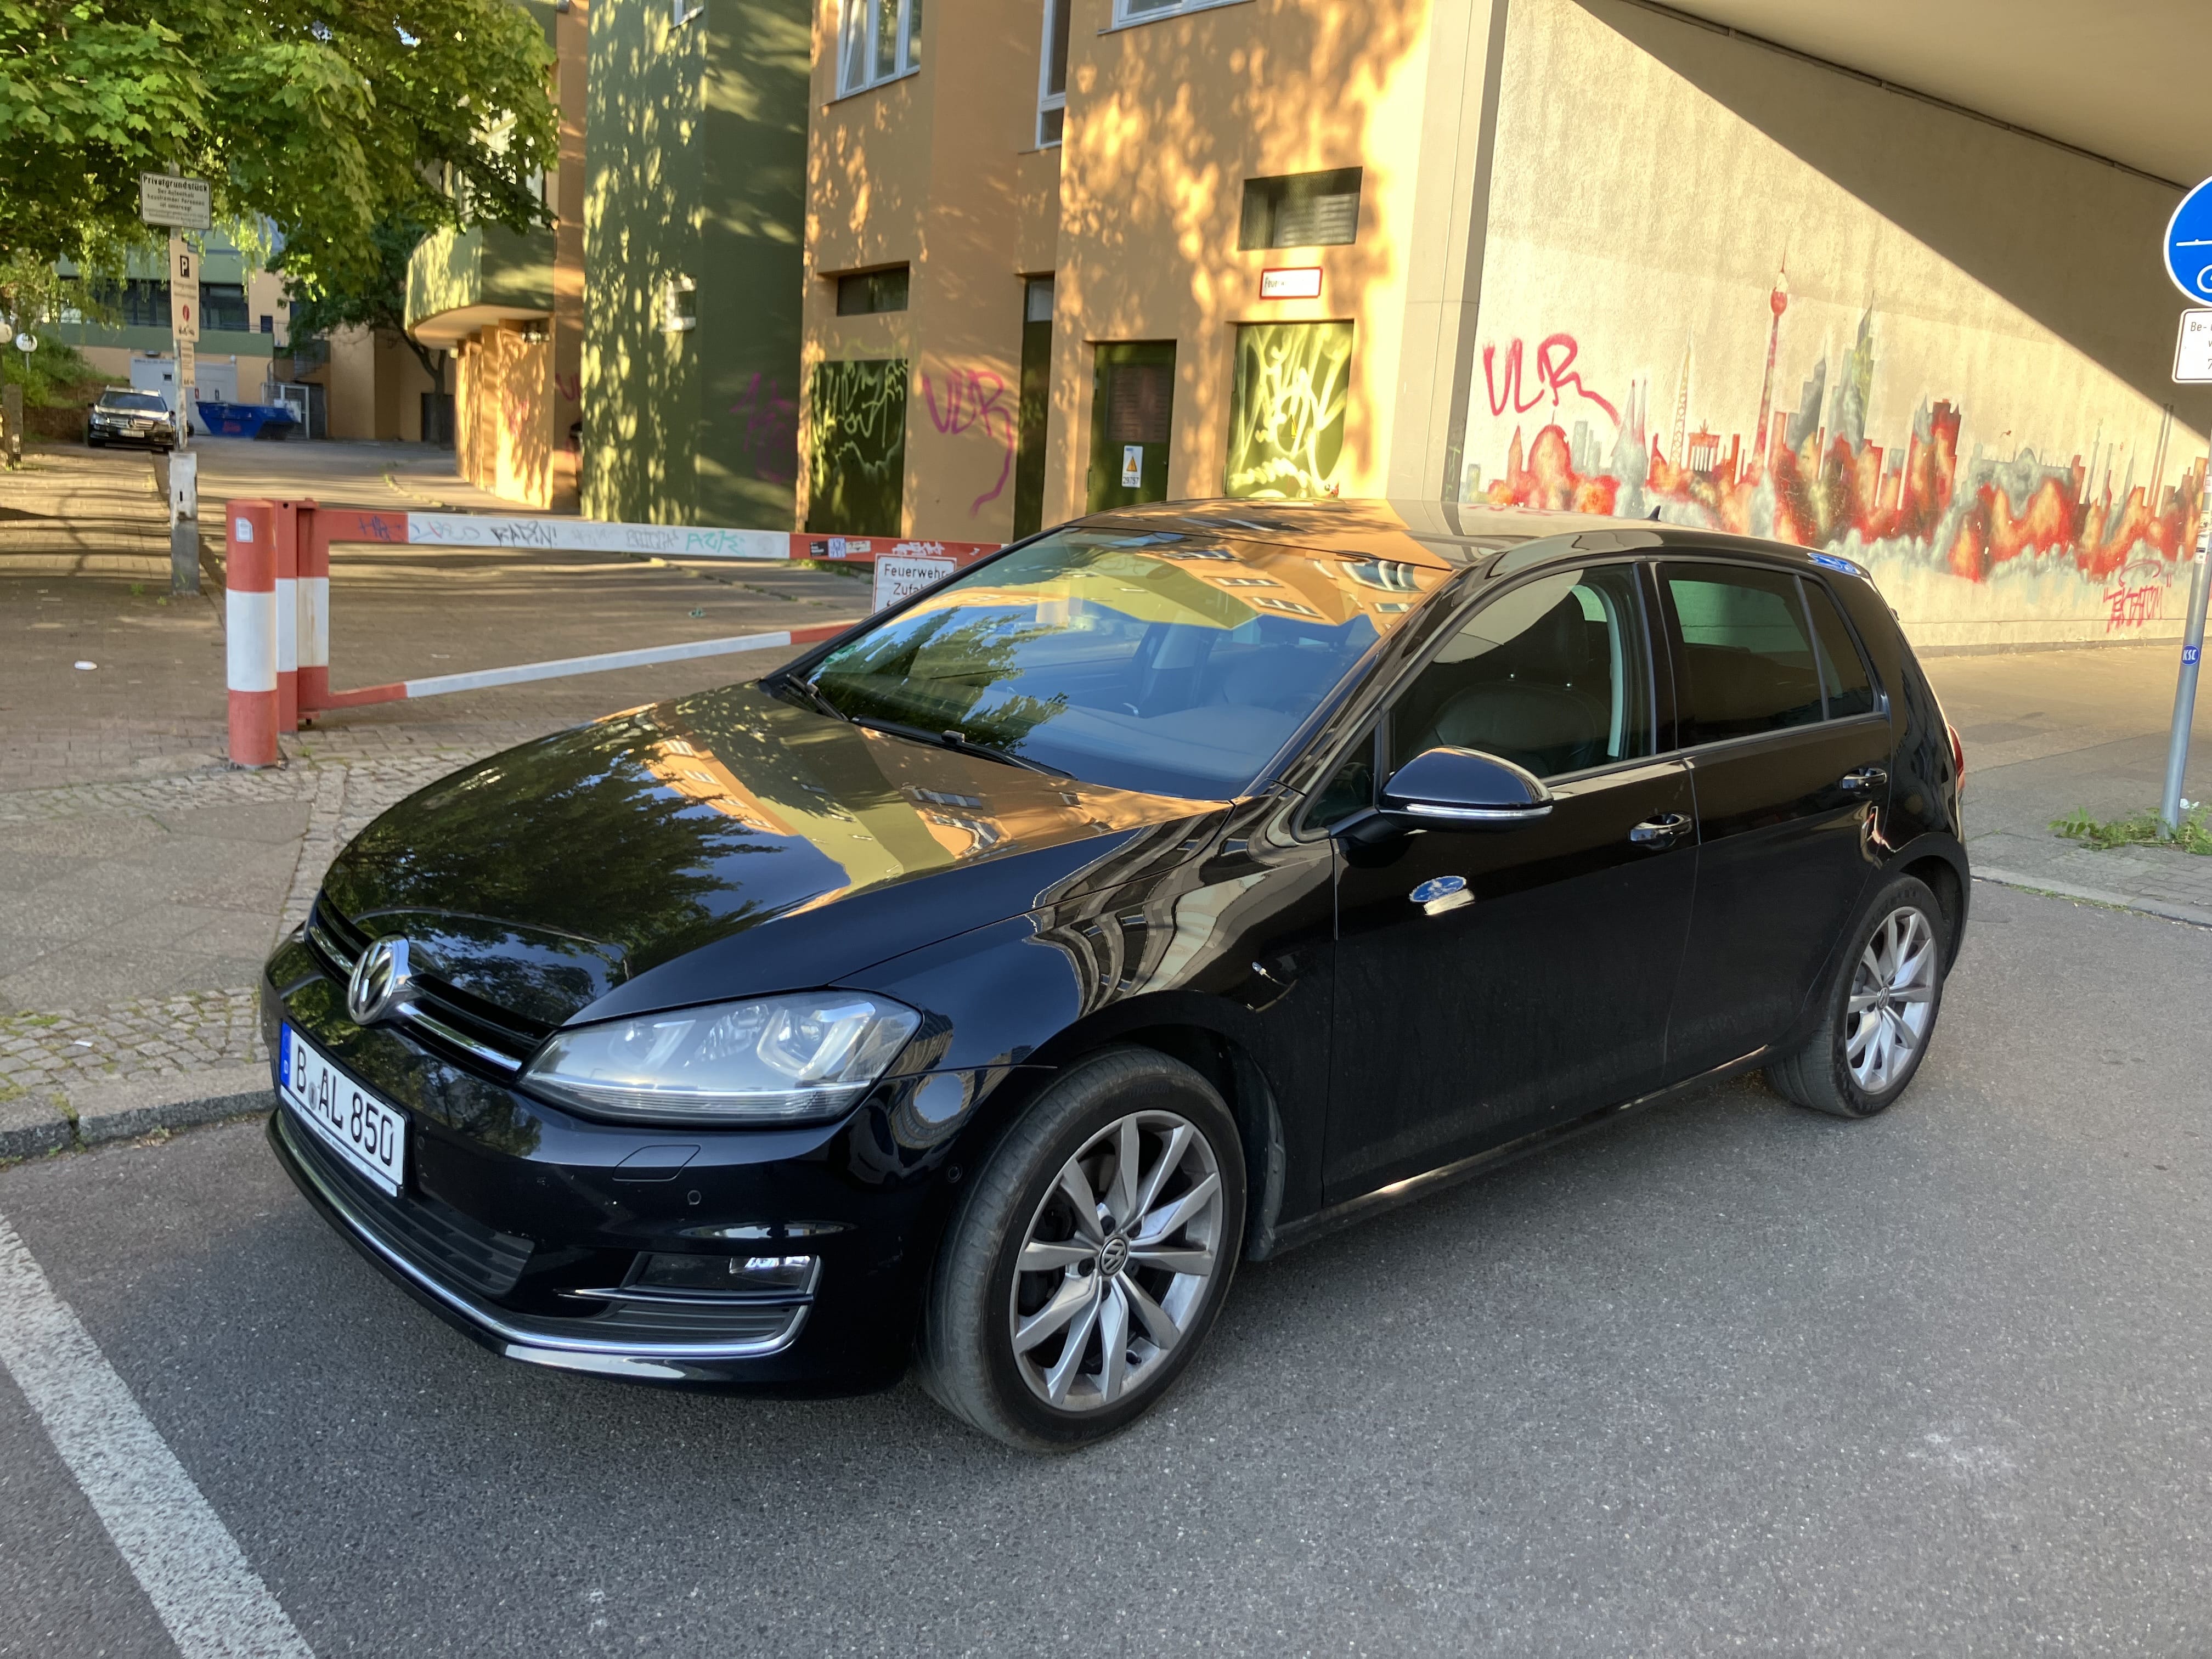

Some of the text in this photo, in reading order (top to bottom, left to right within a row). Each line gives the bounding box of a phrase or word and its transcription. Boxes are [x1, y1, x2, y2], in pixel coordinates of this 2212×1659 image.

[2190, 321, 2207, 332] Be-
[2182, 649, 2197, 661] KSC
[297, 1043, 307, 1094] B
[318, 1066, 344, 1130] AL
[351, 1092, 394, 1167] 850
